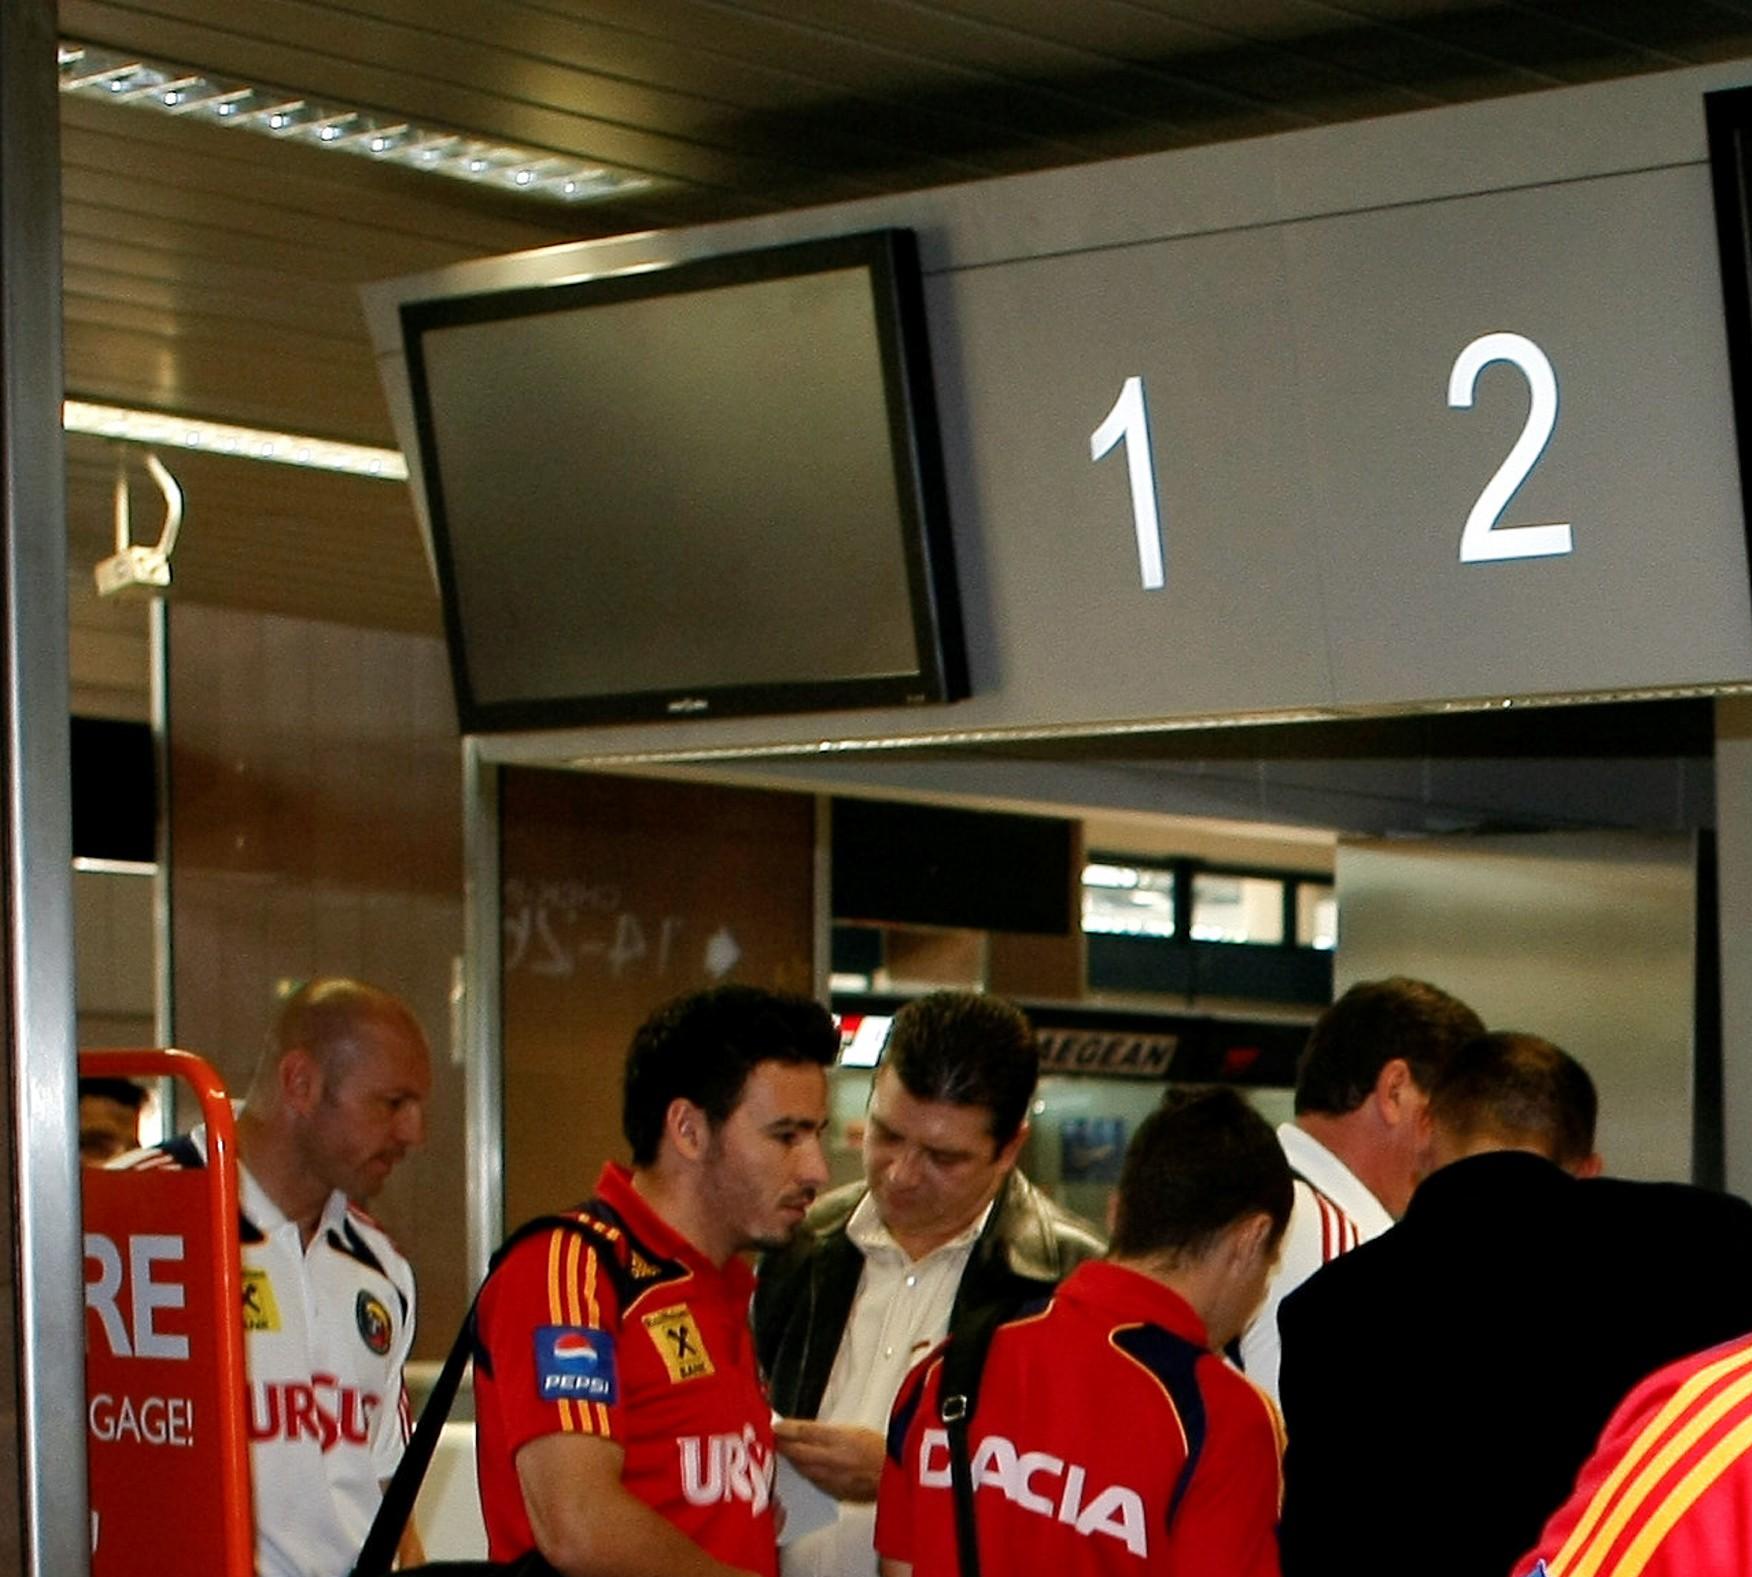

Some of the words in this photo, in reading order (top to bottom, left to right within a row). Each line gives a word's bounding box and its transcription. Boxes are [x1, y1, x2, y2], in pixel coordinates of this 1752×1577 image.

[1090, 376, 1166, 590] 1
[1447, 332, 1574, 564] 2
[545, 1373, 610, 1395] PEPSI
[918, 1428, 1148, 1559] DACIA
